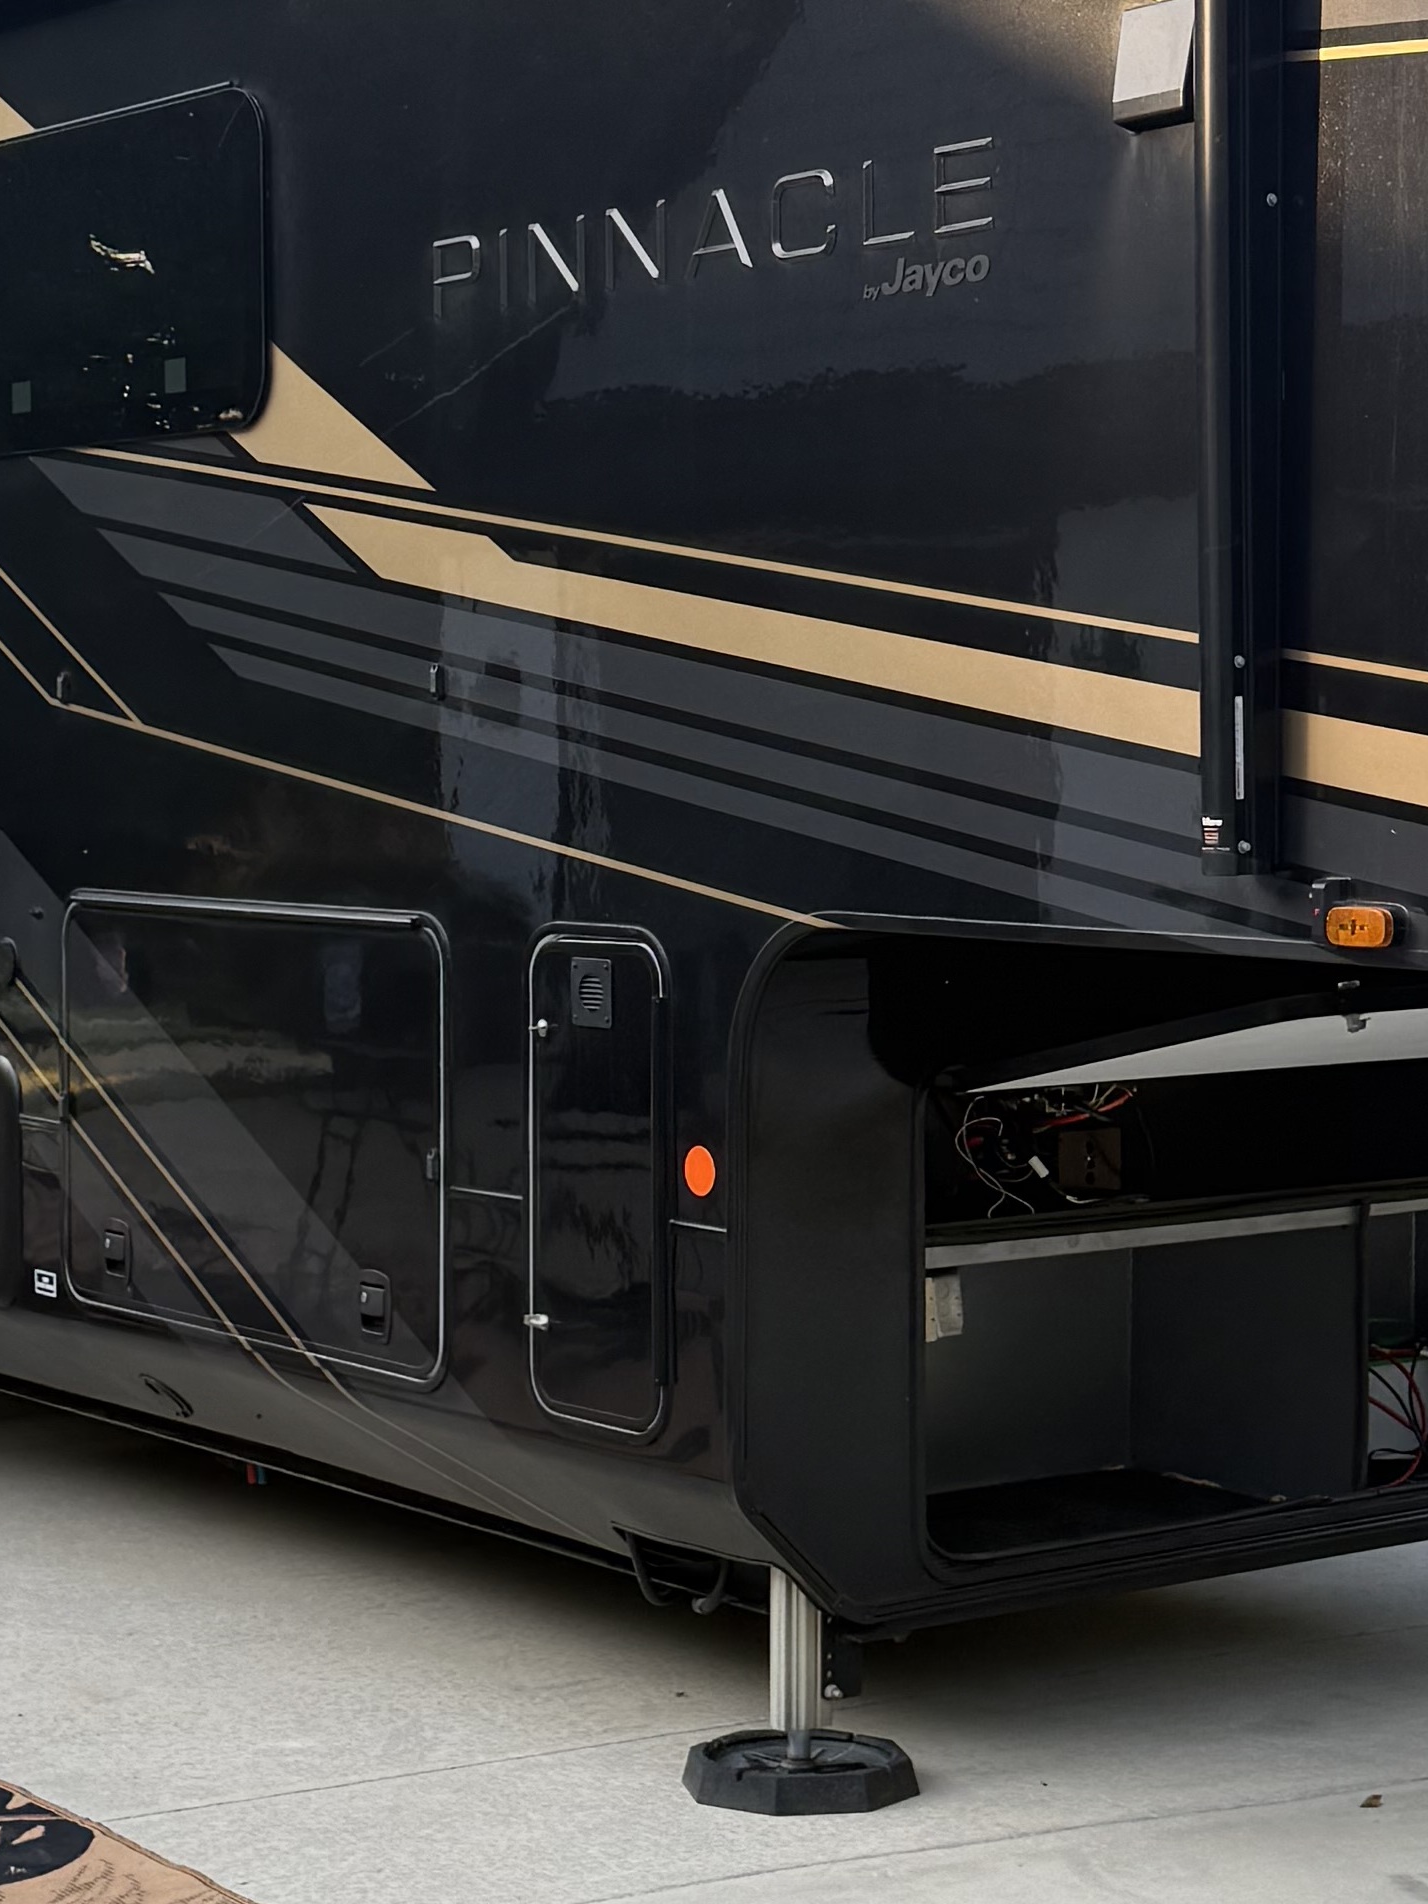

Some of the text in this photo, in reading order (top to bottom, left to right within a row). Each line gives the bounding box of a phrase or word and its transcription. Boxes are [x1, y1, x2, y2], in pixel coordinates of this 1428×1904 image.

[433, 137, 994, 320] PINNACLE
[862, 254, 990, 301] by Jayco
